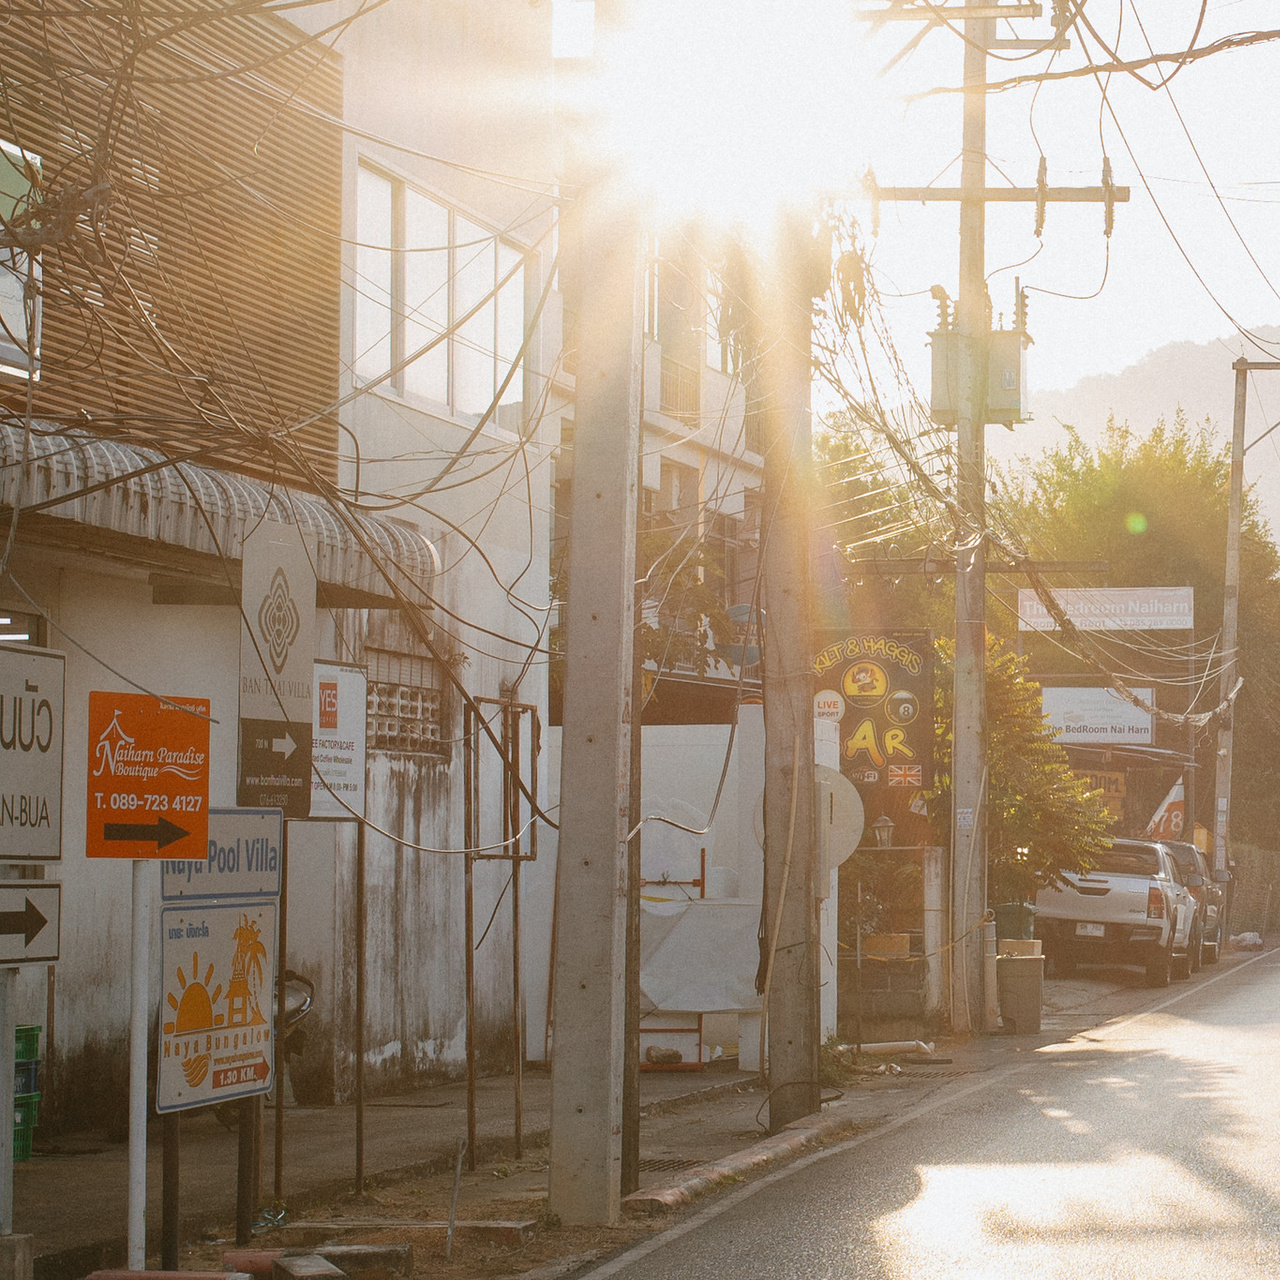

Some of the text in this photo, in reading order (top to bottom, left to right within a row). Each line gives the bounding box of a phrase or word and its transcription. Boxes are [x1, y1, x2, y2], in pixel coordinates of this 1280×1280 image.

[1128, 600, 1189, 614] Naiharn
[813, 635, 921, 674] KILT & HAGGIS
[242, 676, 312, 700] BAN THAI VILLA
[320, 689, 338, 711] YES
[817, 700, 839, 709] LIVE
[902, 704, 910, 717] 8
[1065, 724, 1108, 734] BedRoom
[1110, 725, 1126, 734] Nai
[1127, 725, 1150, 734] Harn
[93, 739, 205, 776] Naiharn Paradise
[115, 762, 159, 782] Boutique
[0, 793, 51, 828] N-BUA
[94, 792, 203, 812] T. 089-723 4127
[207, 838, 241, 874] Pool
[244, 837, 278, 872] Villa
[163, 1027, 271, 1060] Naya Bungalow
[219, 1070, 238, 1086] 1.30
